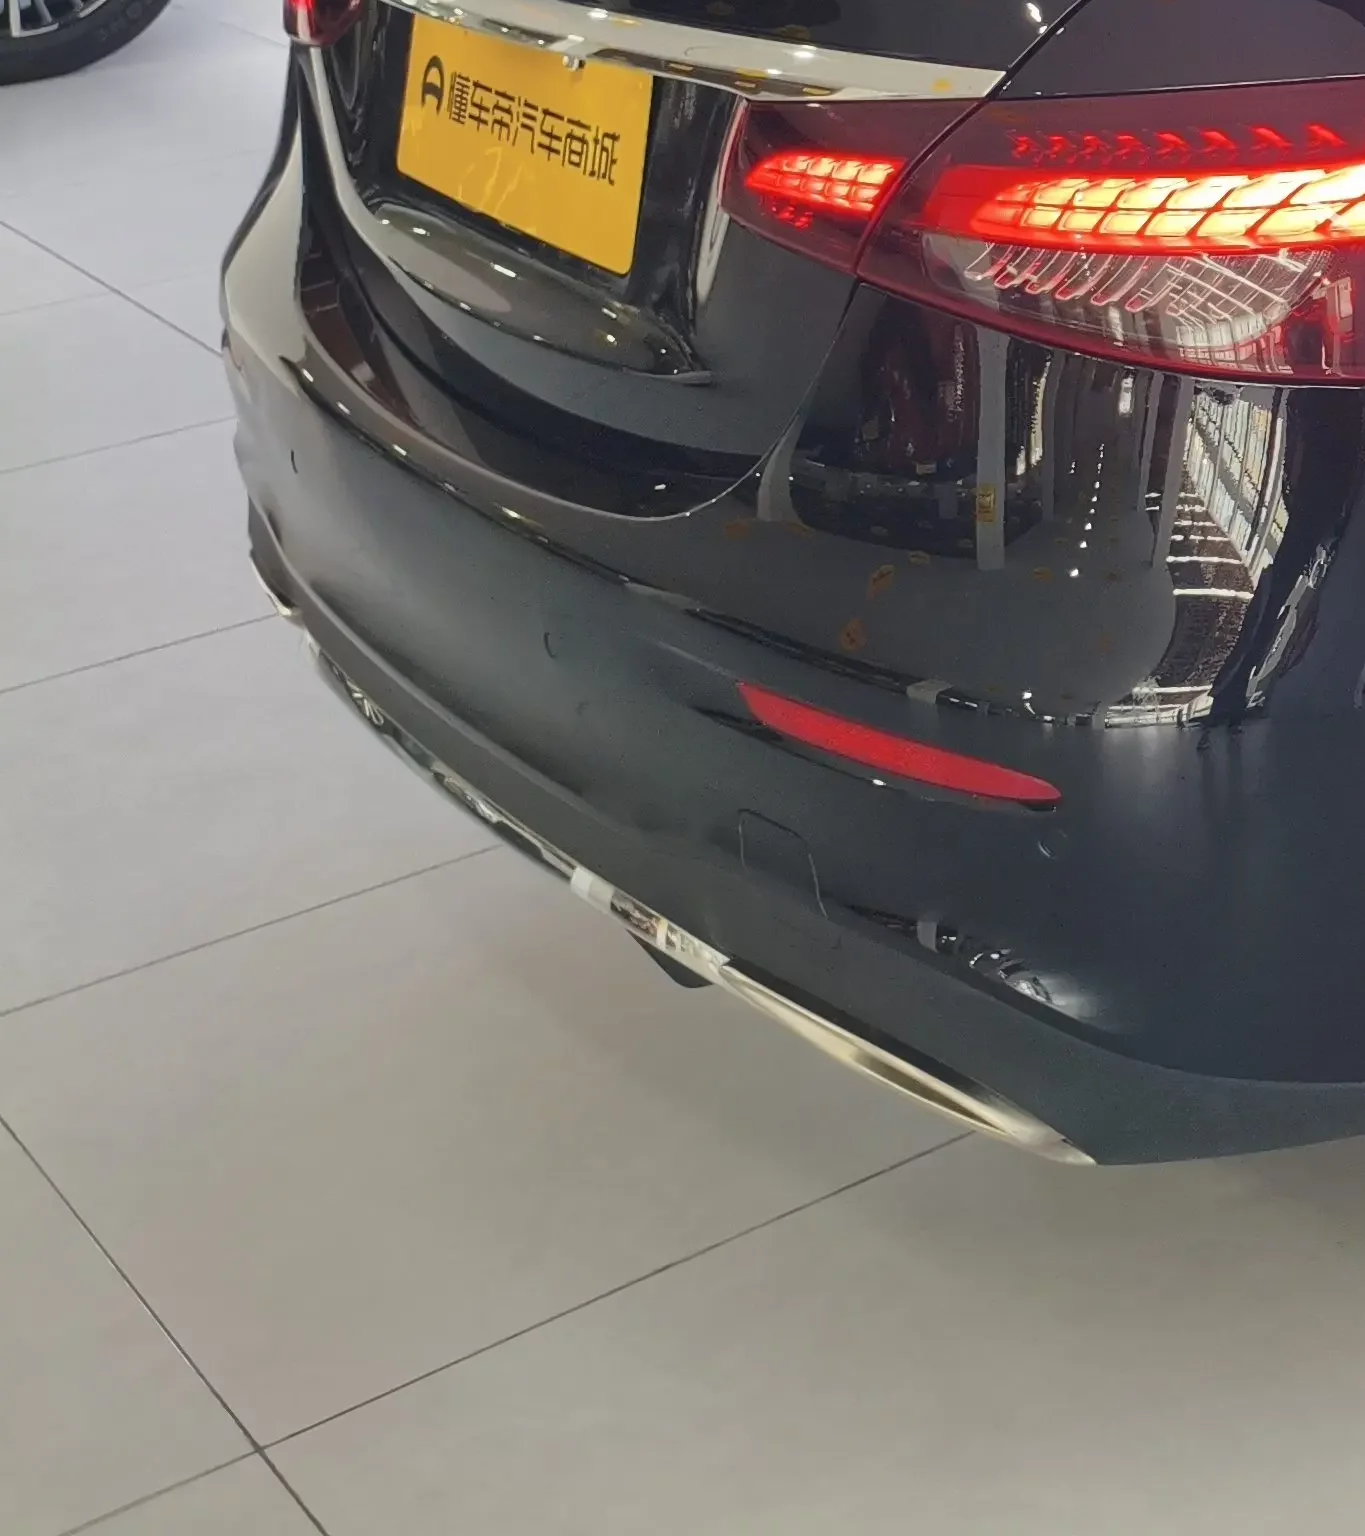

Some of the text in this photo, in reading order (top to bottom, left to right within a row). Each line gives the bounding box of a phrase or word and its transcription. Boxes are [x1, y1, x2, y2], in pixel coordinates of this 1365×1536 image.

[447, 71, 620, 186] 懂车帝汽车商城
